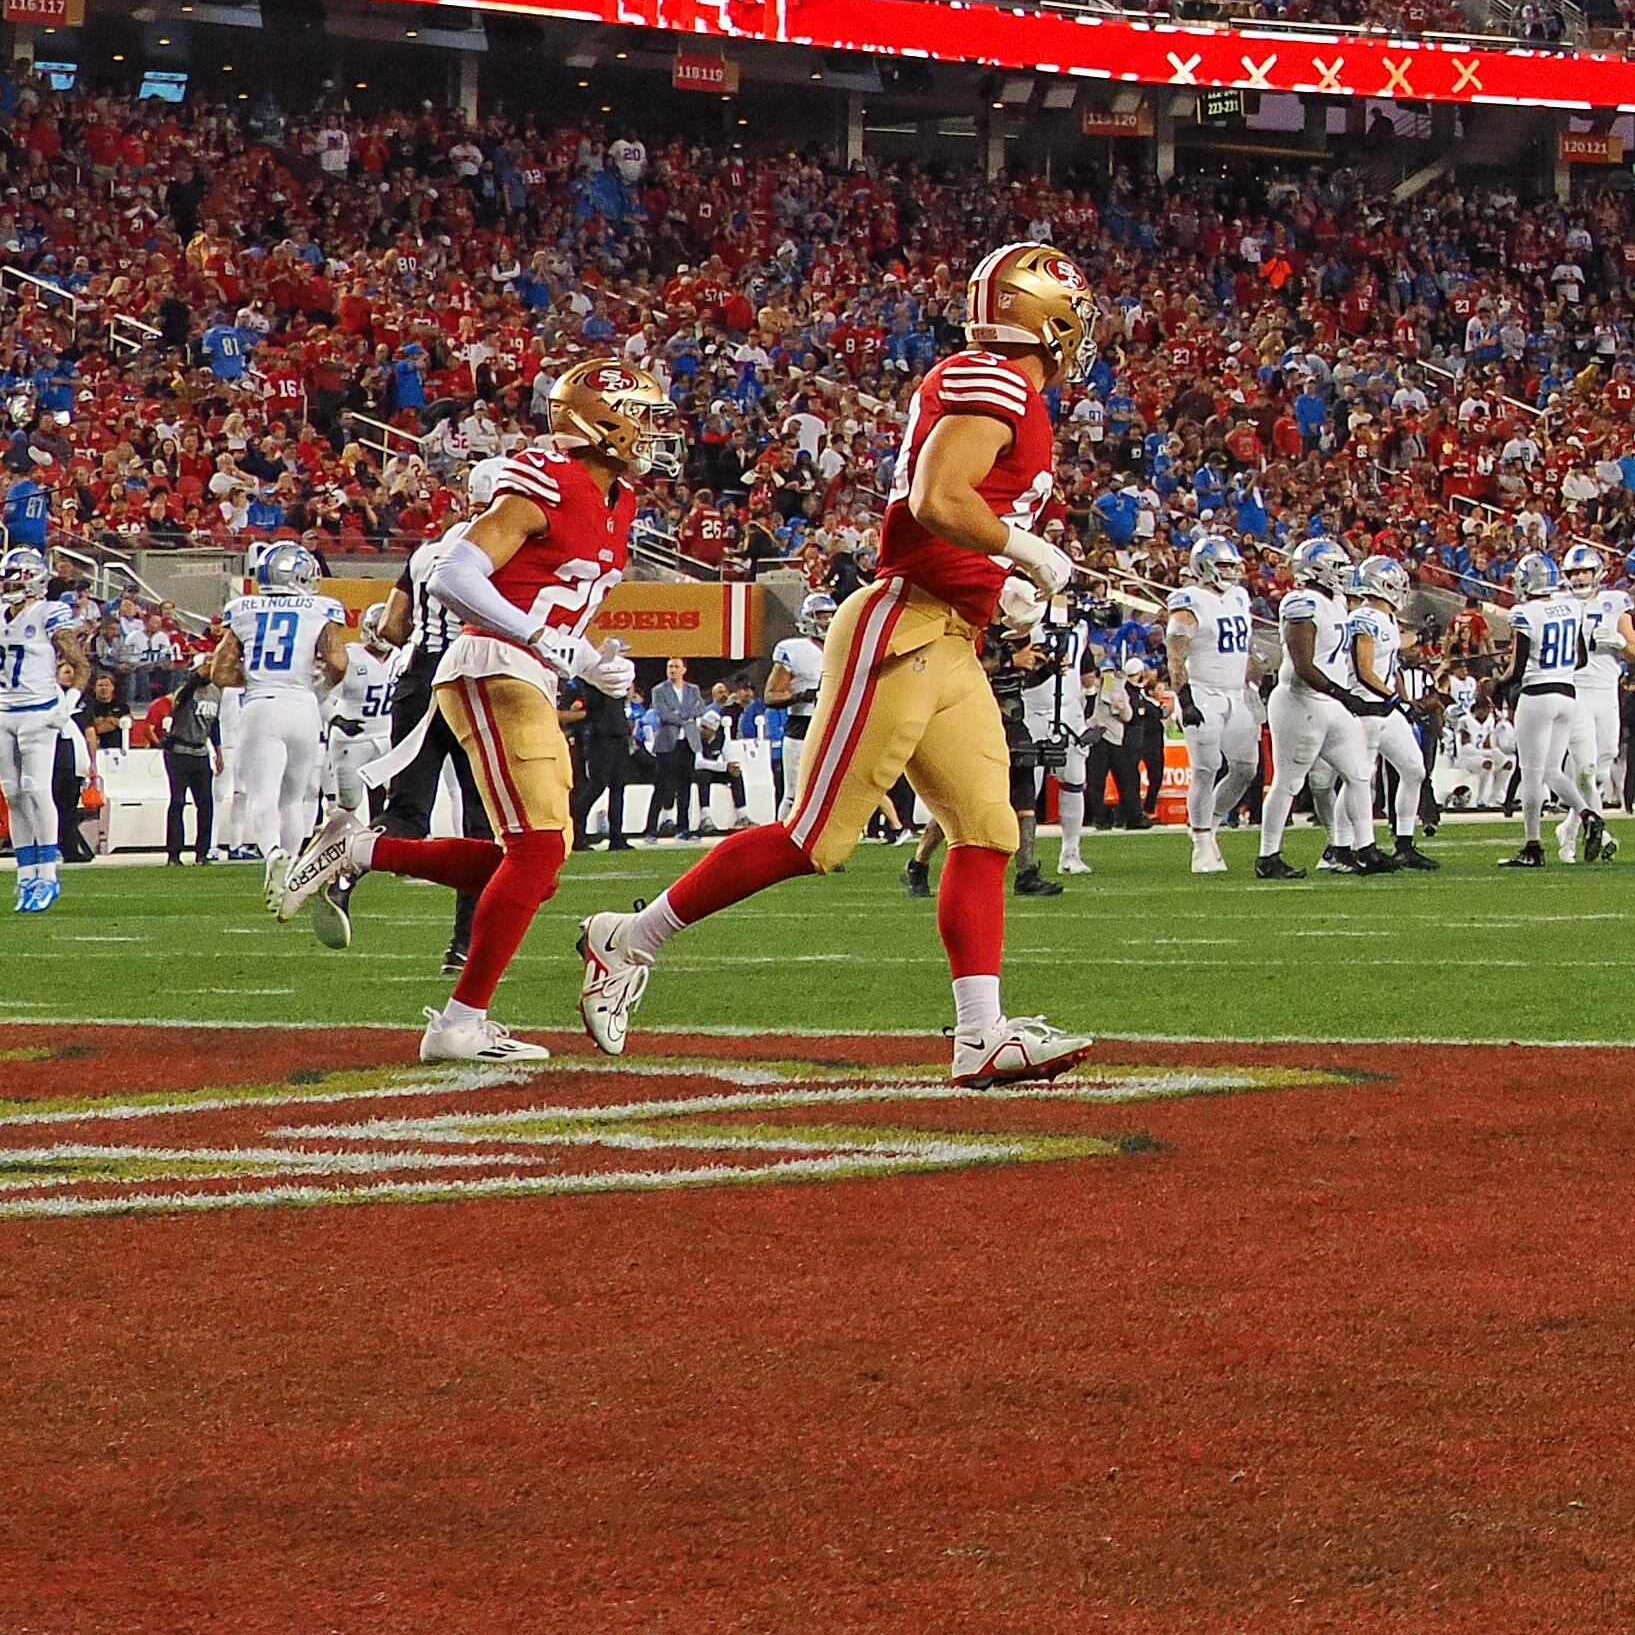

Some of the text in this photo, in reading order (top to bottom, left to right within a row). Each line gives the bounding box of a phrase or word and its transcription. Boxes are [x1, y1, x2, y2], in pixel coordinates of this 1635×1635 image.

[623, 147, 641, 162] 20
[221, 337, 240, 357] 81
[1173, 347, 1190, 366] 23
[278, 379, 298, 398] 16
[701, 520, 723, 540] 26
[241, 596, 315, 611] REYNOLDS
[1544, 604, 1572, 619] GREEN
[593, 610, 700, 630] 49ERS
[249, 612, 299, 671] 13
[1217, 616, 1248, 653] 68
[1539, 618, 1576, 669] 80
